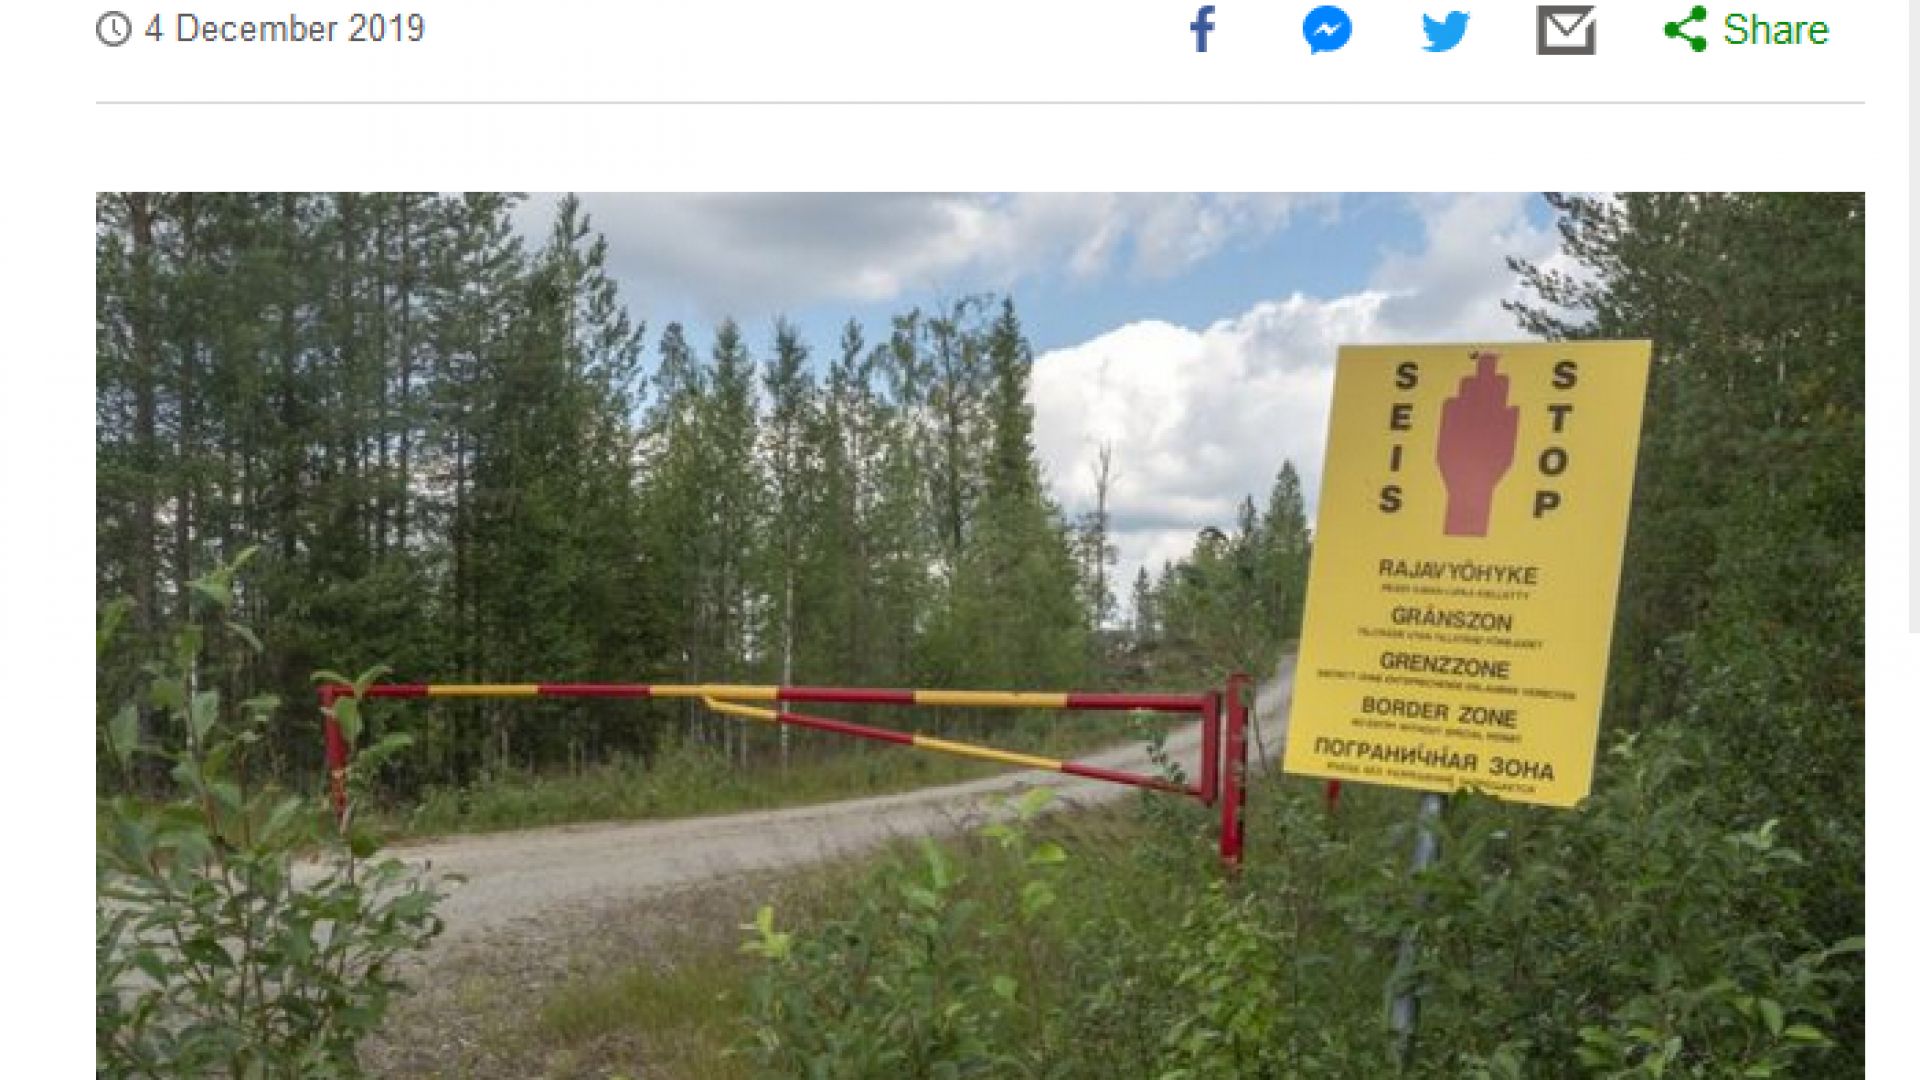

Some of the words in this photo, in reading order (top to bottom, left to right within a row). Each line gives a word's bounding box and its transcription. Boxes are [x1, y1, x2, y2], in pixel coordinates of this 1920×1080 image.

[144, 13, 165, 42] 4
[176, 13, 339, 42] December
[348, 13, 426, 42] 2019
[1723, 13, 1830, 46] Share
[1379, 361, 1419, 514] SEIS
[1532, 358, 1578, 519] STOP
[1379, 651, 1511, 680] GRENZZONE
[1361, 695, 1449, 721] BORDER
[1458, 706, 1518, 729] ZONE
[1489, 756, 1556, 782] ЗОНА
